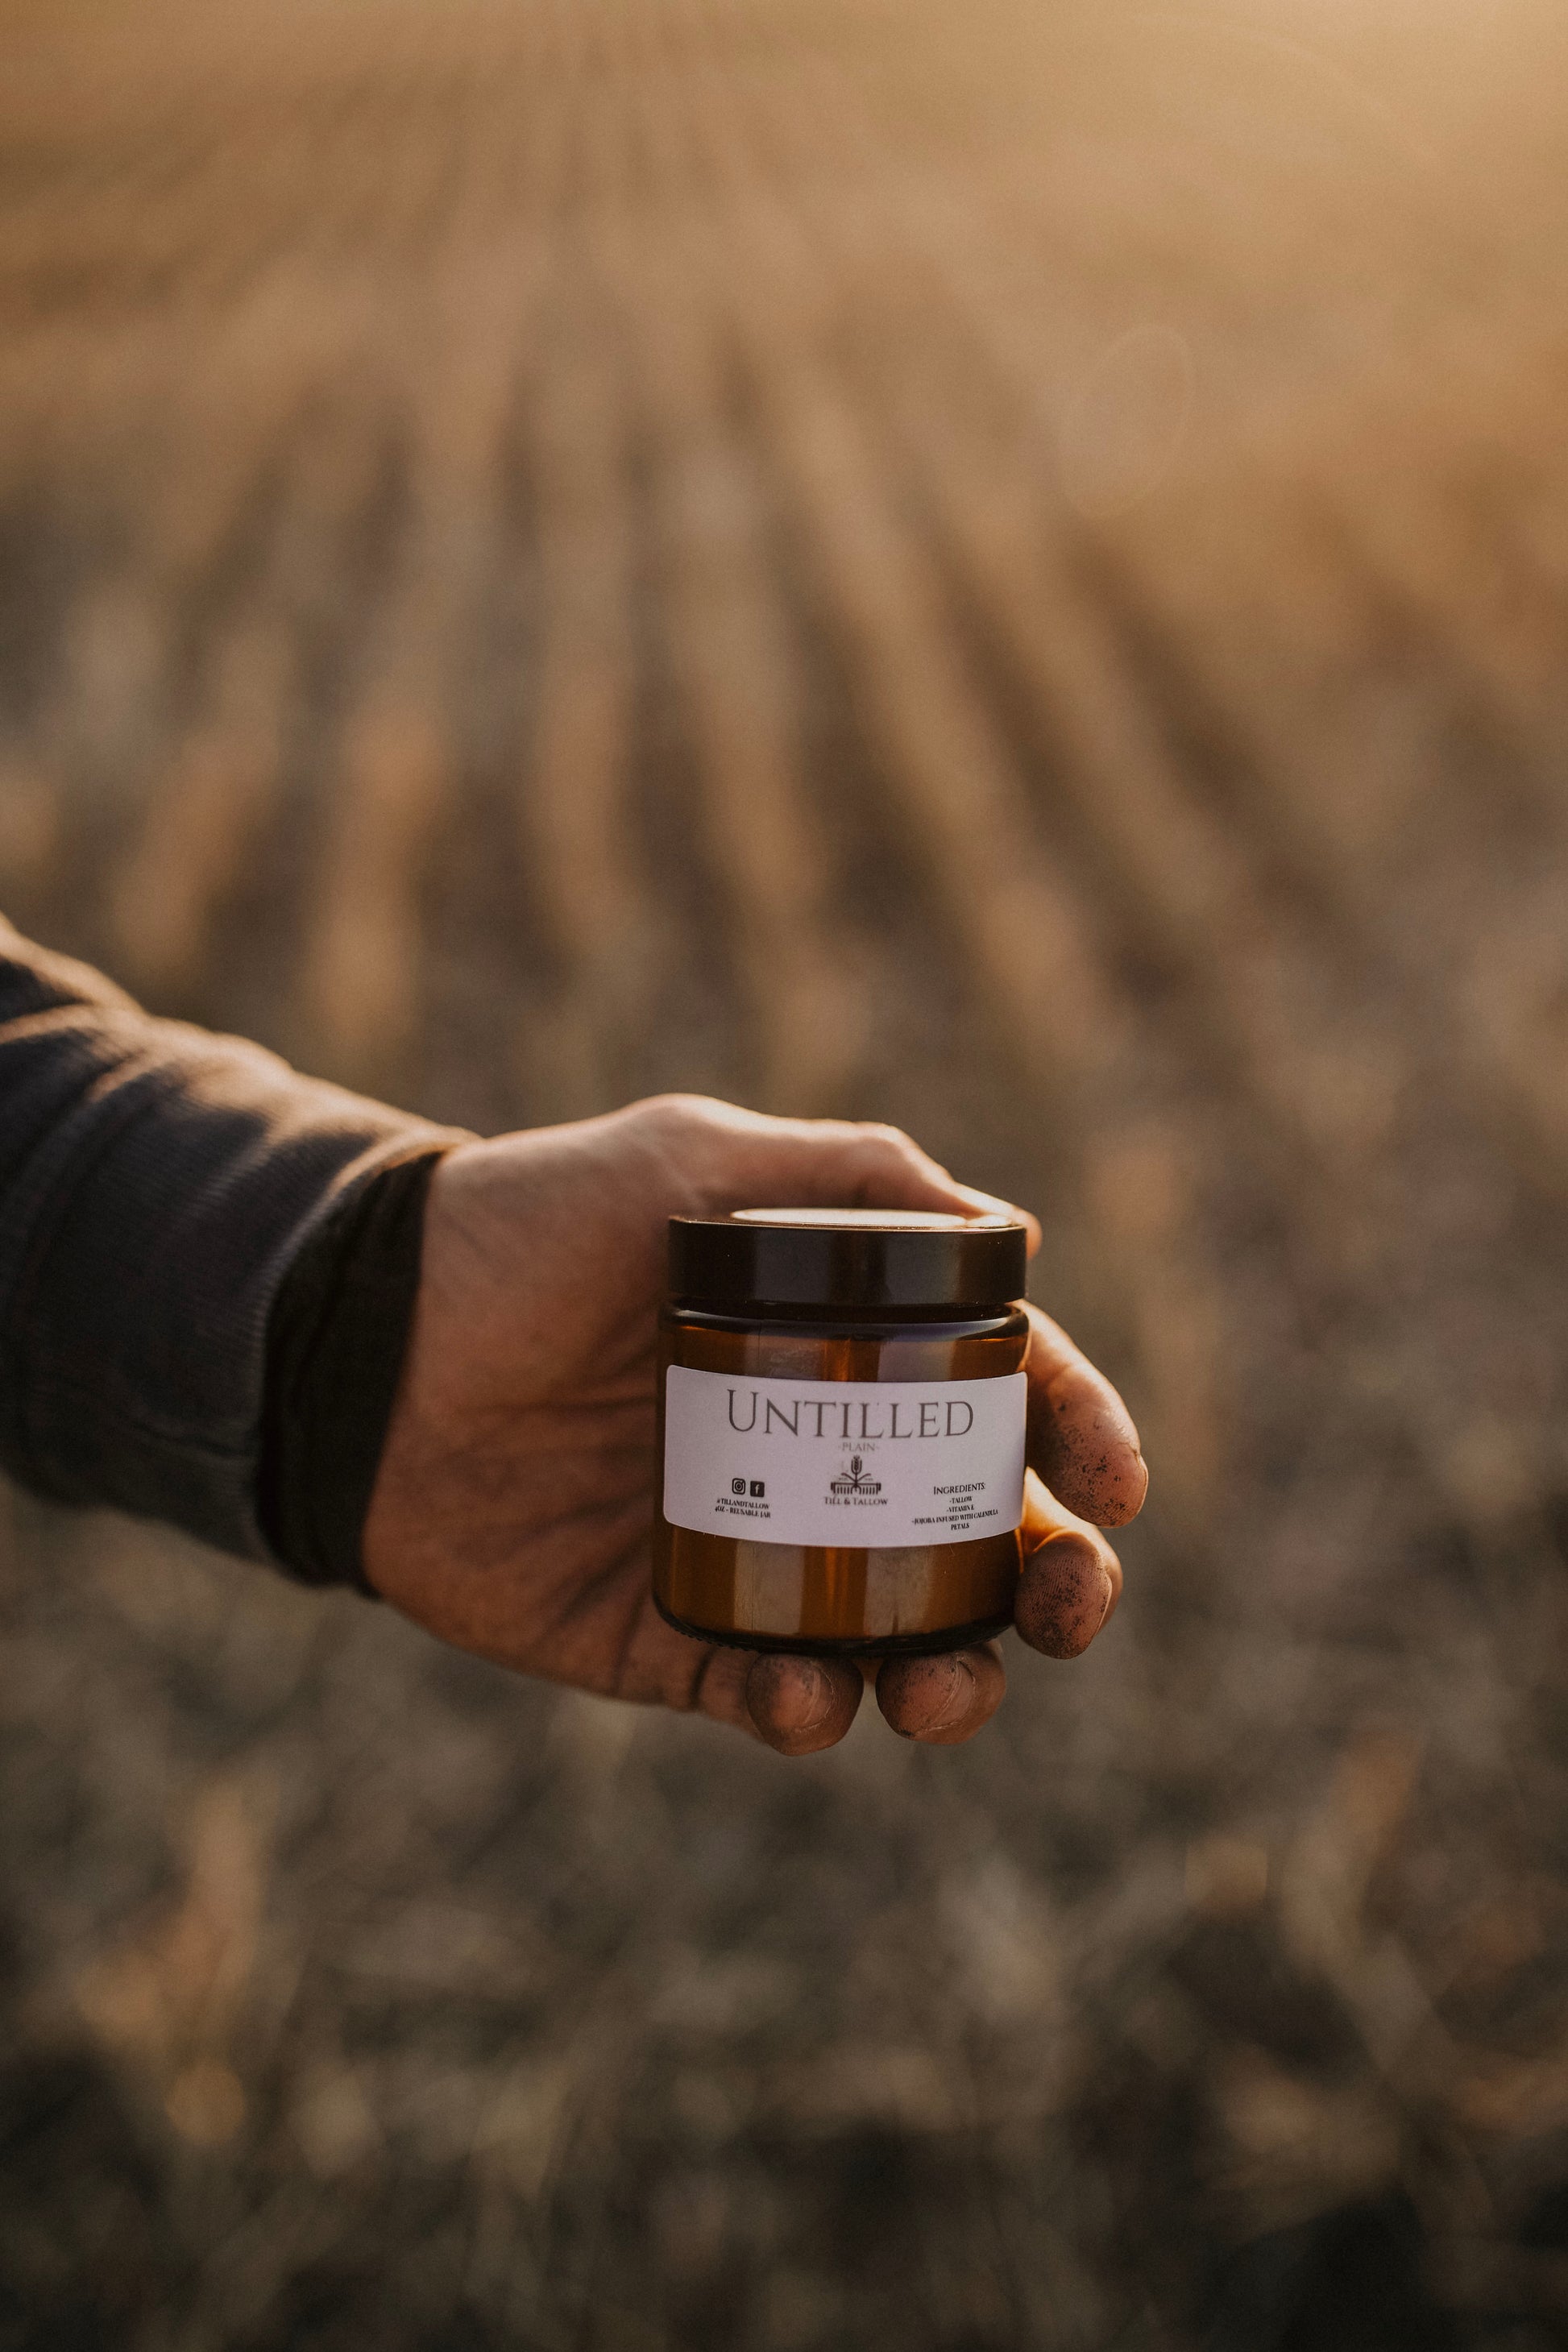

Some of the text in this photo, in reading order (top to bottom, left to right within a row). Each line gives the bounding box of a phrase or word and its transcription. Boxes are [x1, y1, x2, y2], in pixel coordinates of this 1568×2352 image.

[727, 1388, 973, 1438] UNTILLED
[824, 1496, 888, 1505] TILL & TALLOW
[951, 1523, 970, 1531] PETALS
